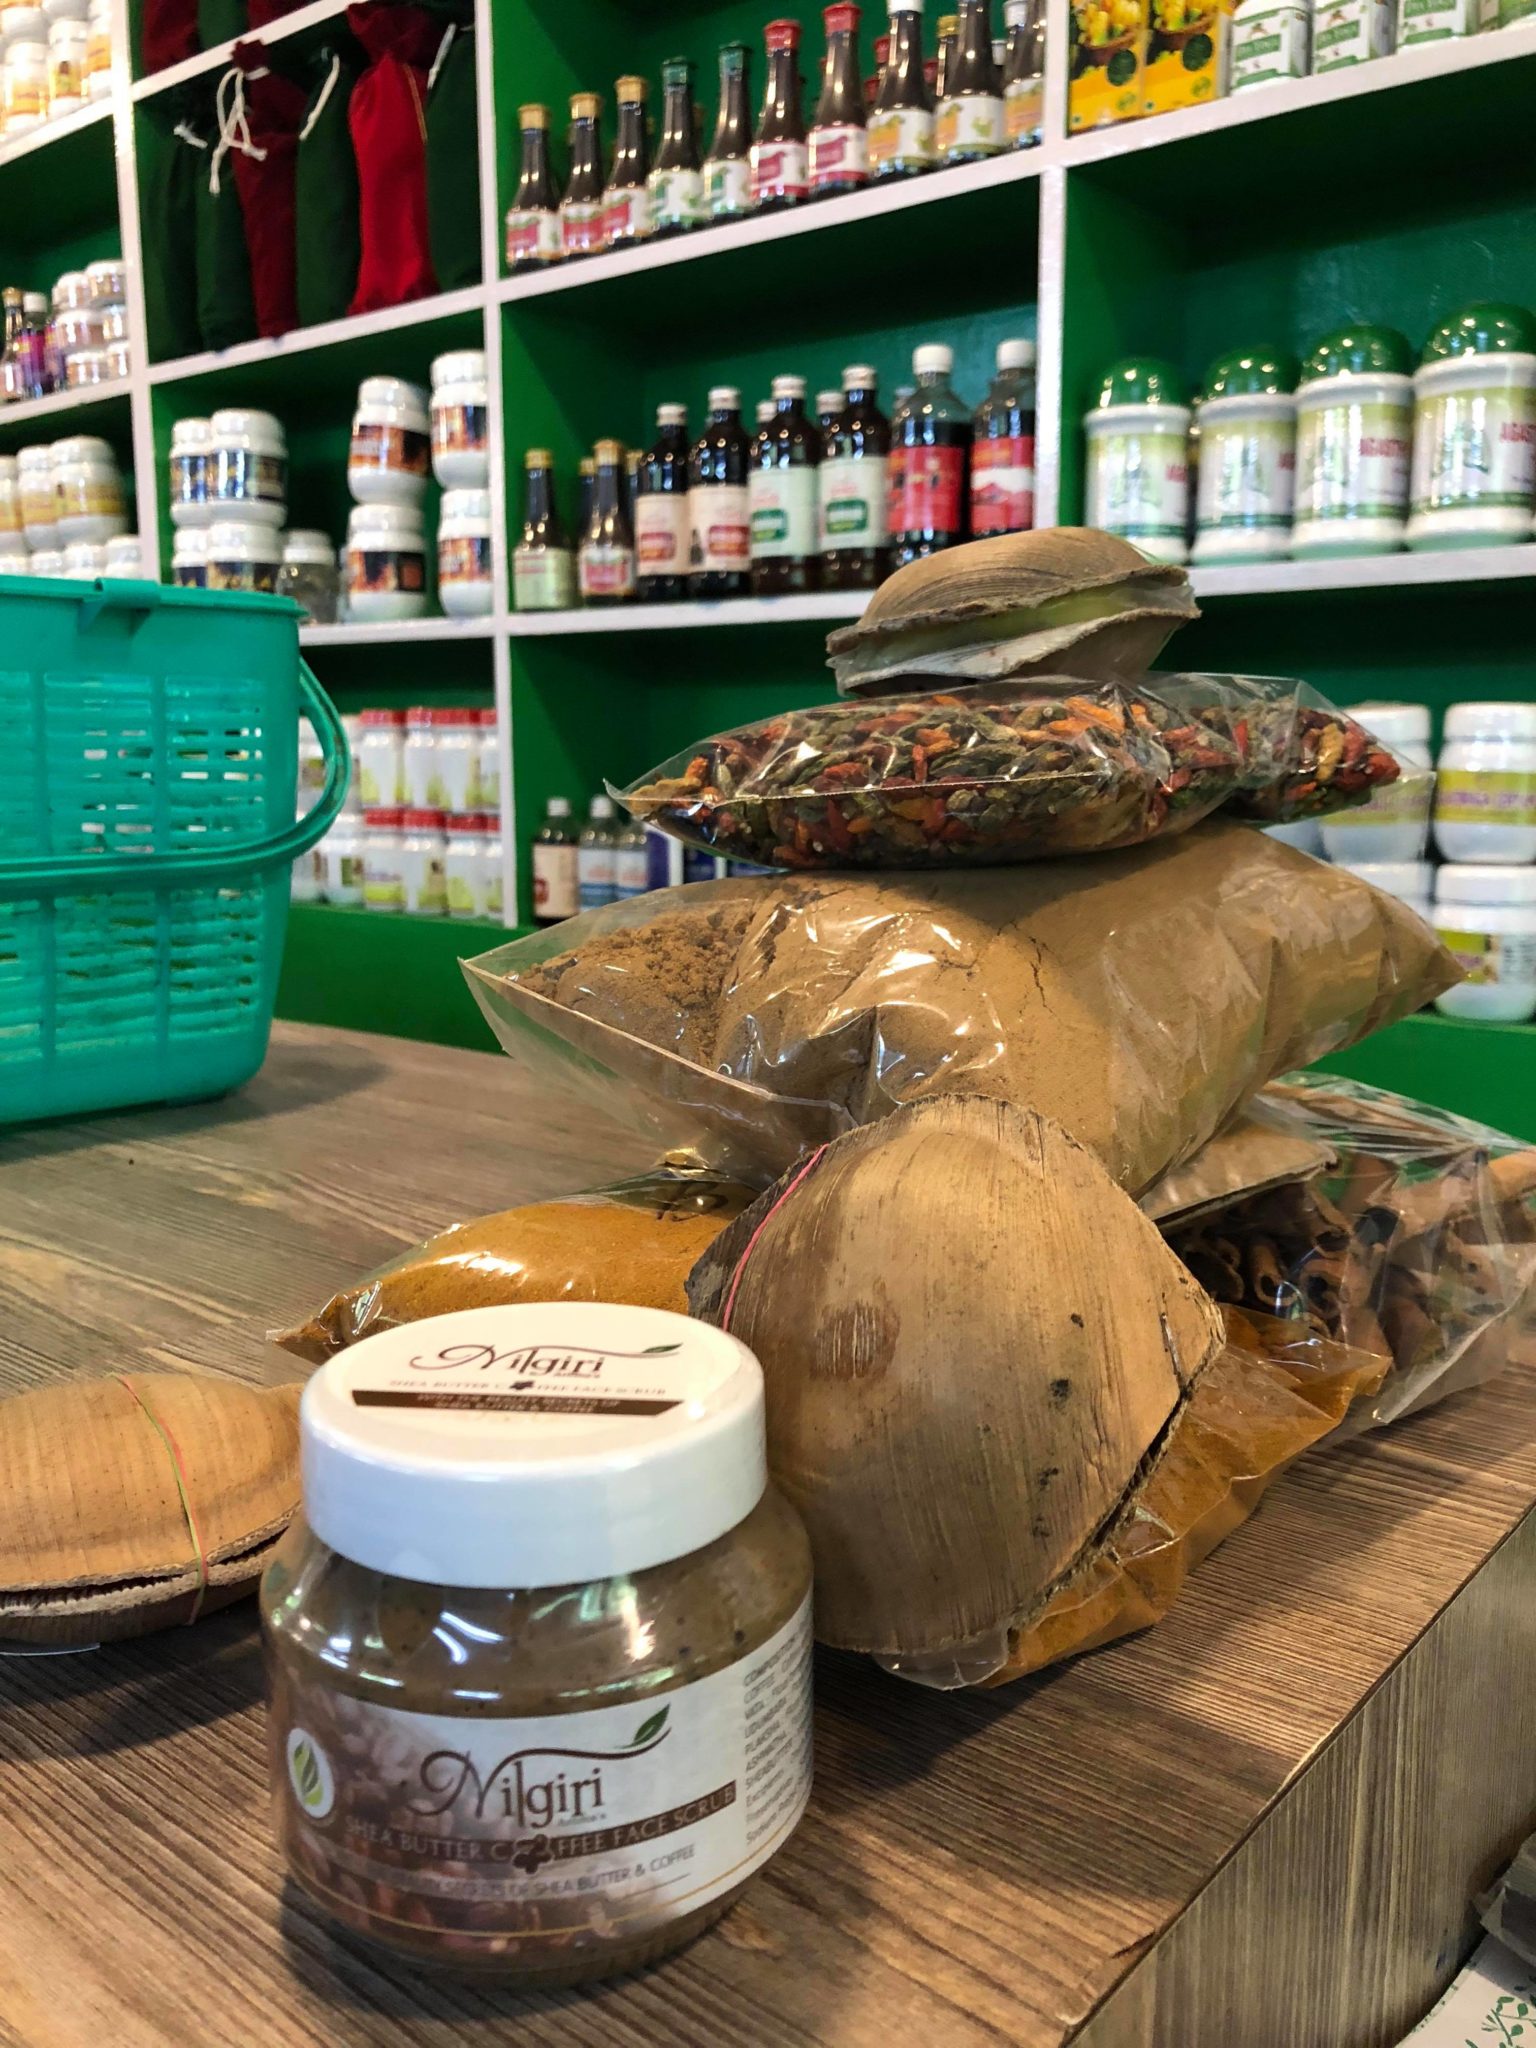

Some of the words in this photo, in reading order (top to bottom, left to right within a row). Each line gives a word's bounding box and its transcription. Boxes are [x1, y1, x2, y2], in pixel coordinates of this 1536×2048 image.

[409, 1344, 606, 1375] Nilgiri
[399, 1749, 605, 1828] Nilgiri
[344, 1815, 394, 1848] SHEA
[401, 1836, 482, 1860] BUTTER
[613, 1815, 669, 1849] FACE
[672, 1784, 736, 1829] SCRUB
[576, 1867, 632, 1892] BUTTER
[650, 1843, 696, 1873] COFFEE
